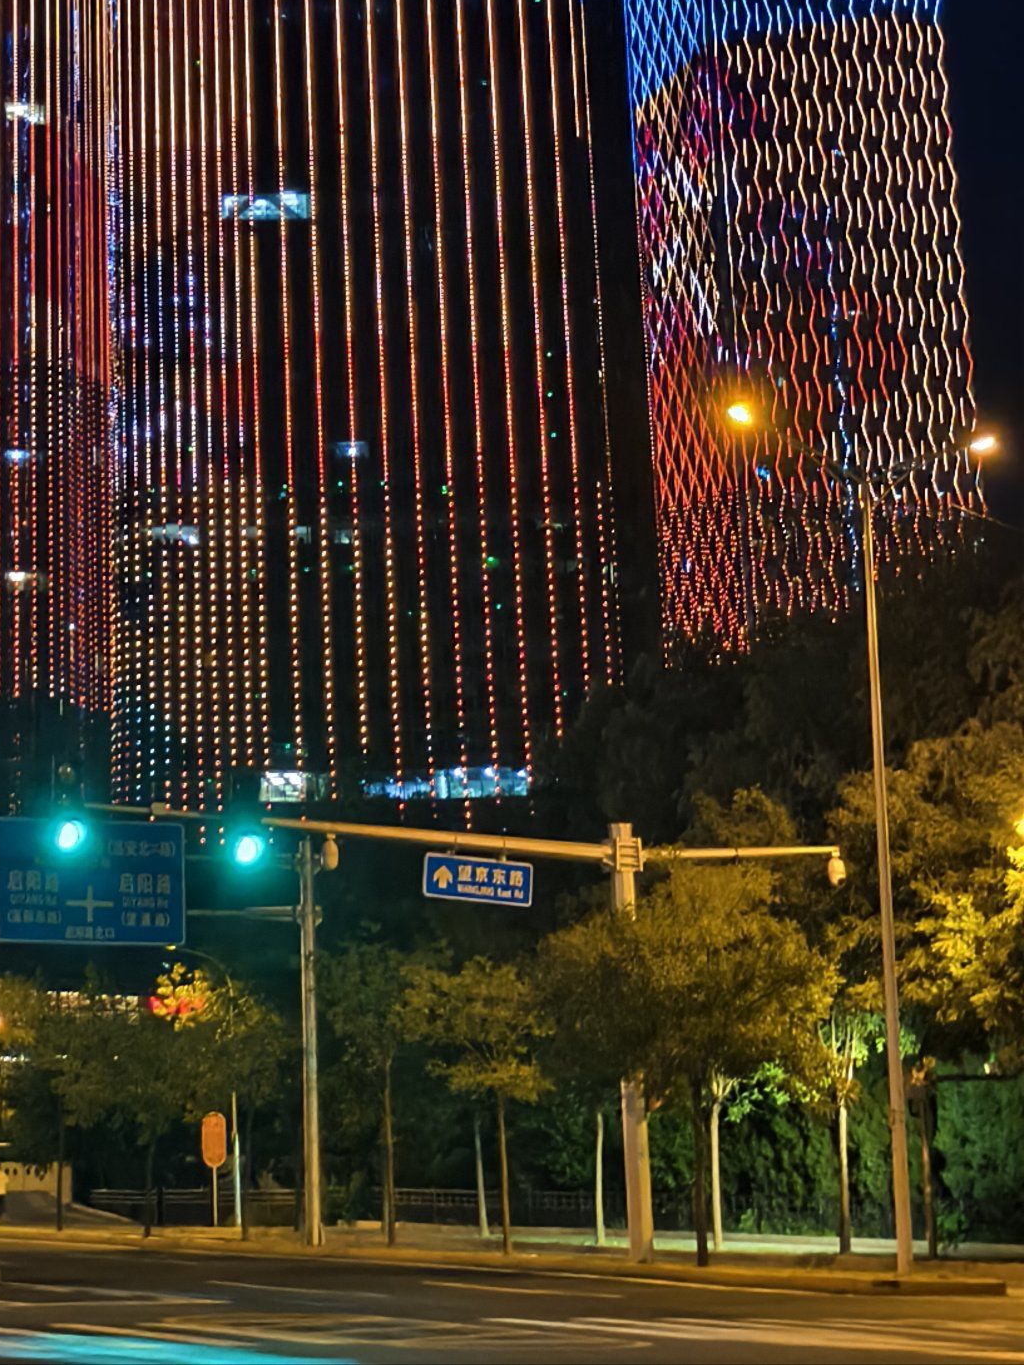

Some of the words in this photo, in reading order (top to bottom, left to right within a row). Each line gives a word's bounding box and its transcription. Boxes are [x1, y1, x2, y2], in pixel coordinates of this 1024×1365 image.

[119, 873, 171, 894] 启阳路
[458, 865, 523, 887] 望京东路
